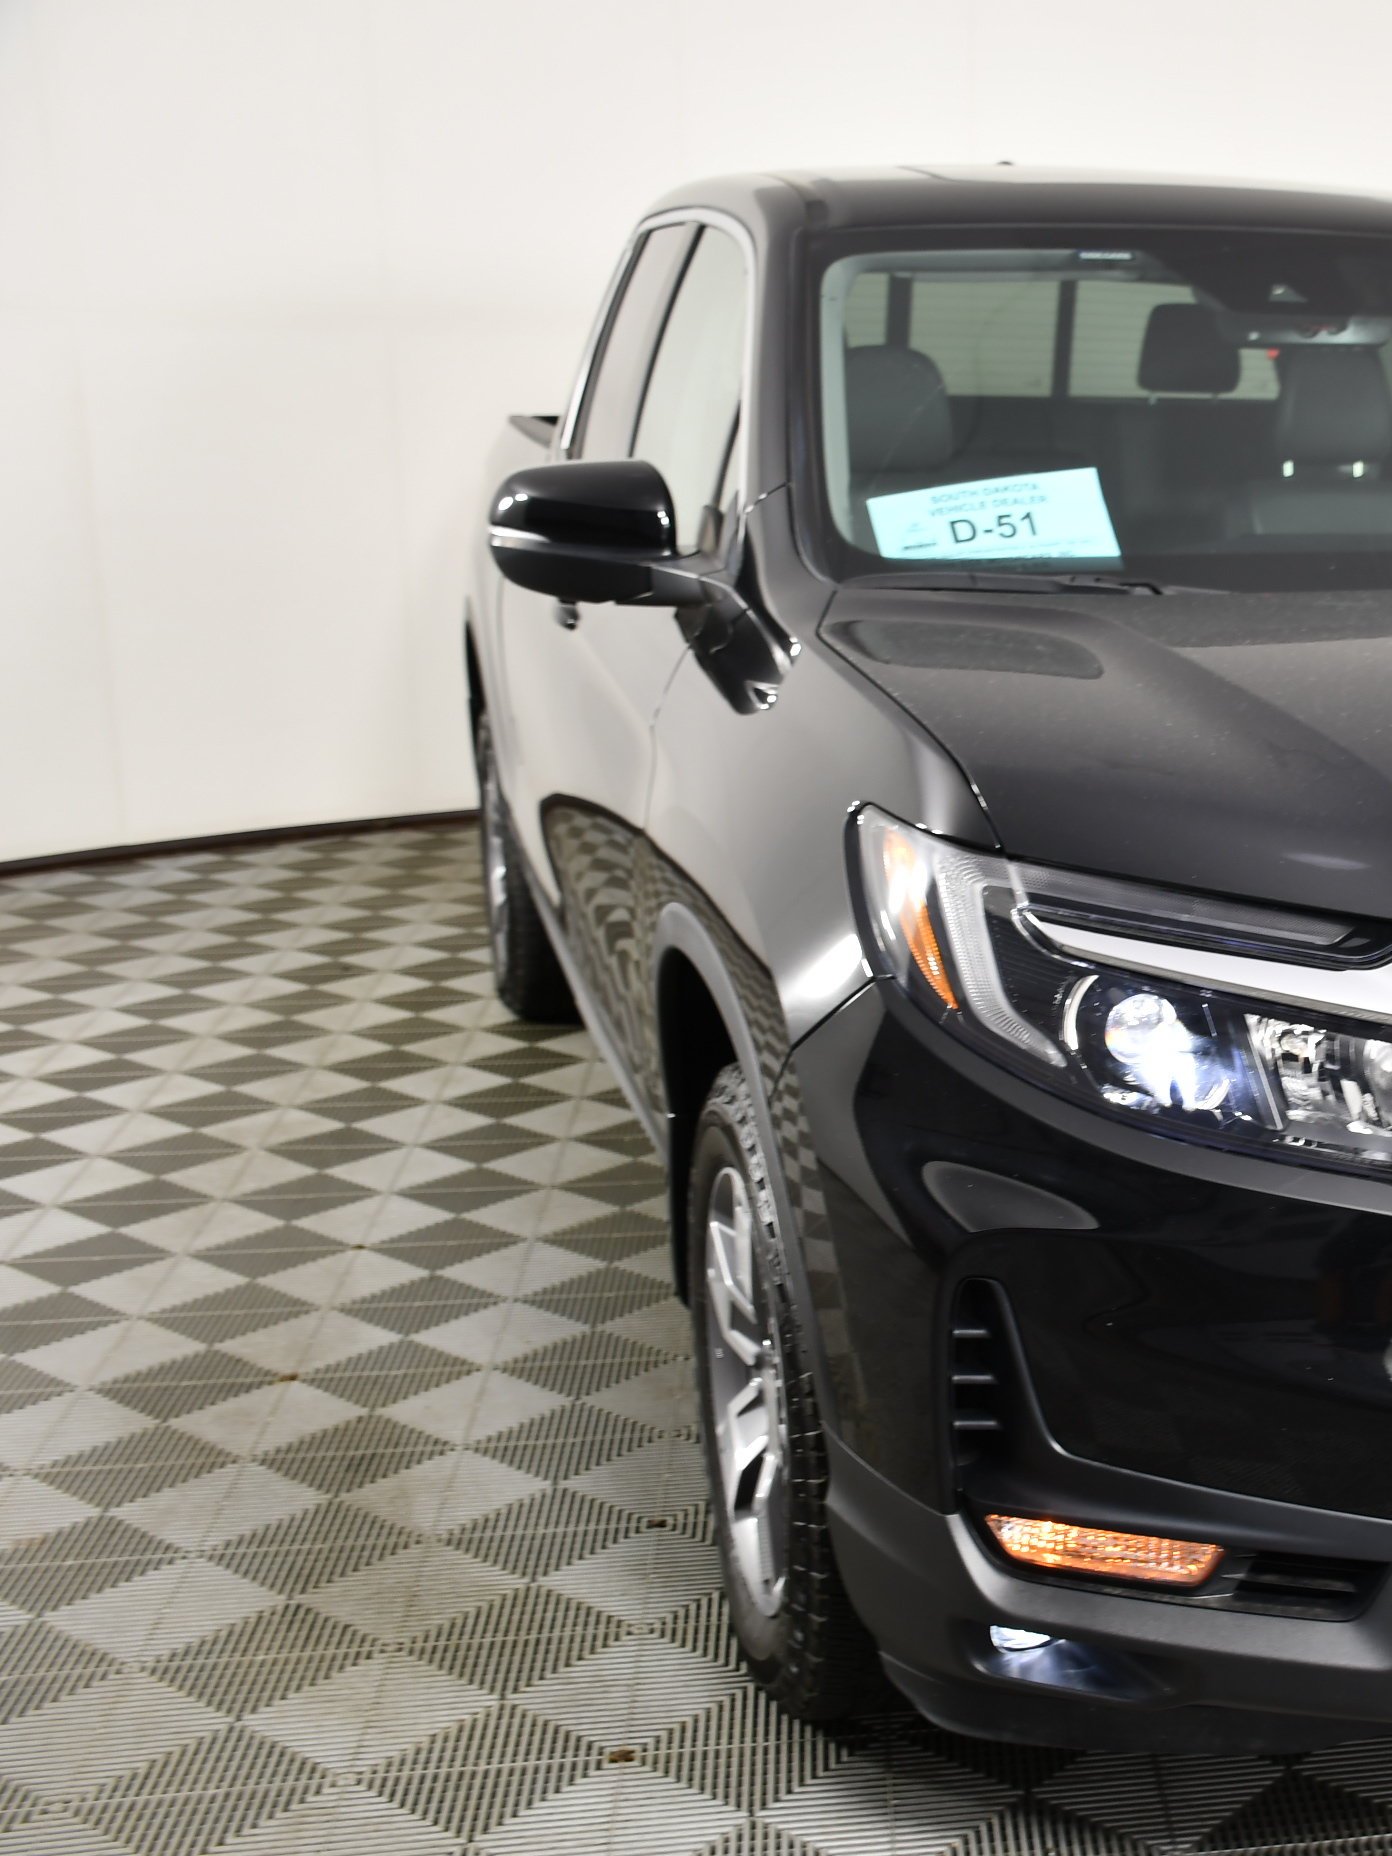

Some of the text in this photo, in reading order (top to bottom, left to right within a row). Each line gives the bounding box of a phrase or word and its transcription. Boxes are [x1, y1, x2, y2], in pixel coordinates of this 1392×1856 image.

[931, 483, 1040, 504] SOUTH DAKOTA
[929, 496, 1046, 517] VEHICLE DEALER
[949, 512, 1038, 544] D-51
